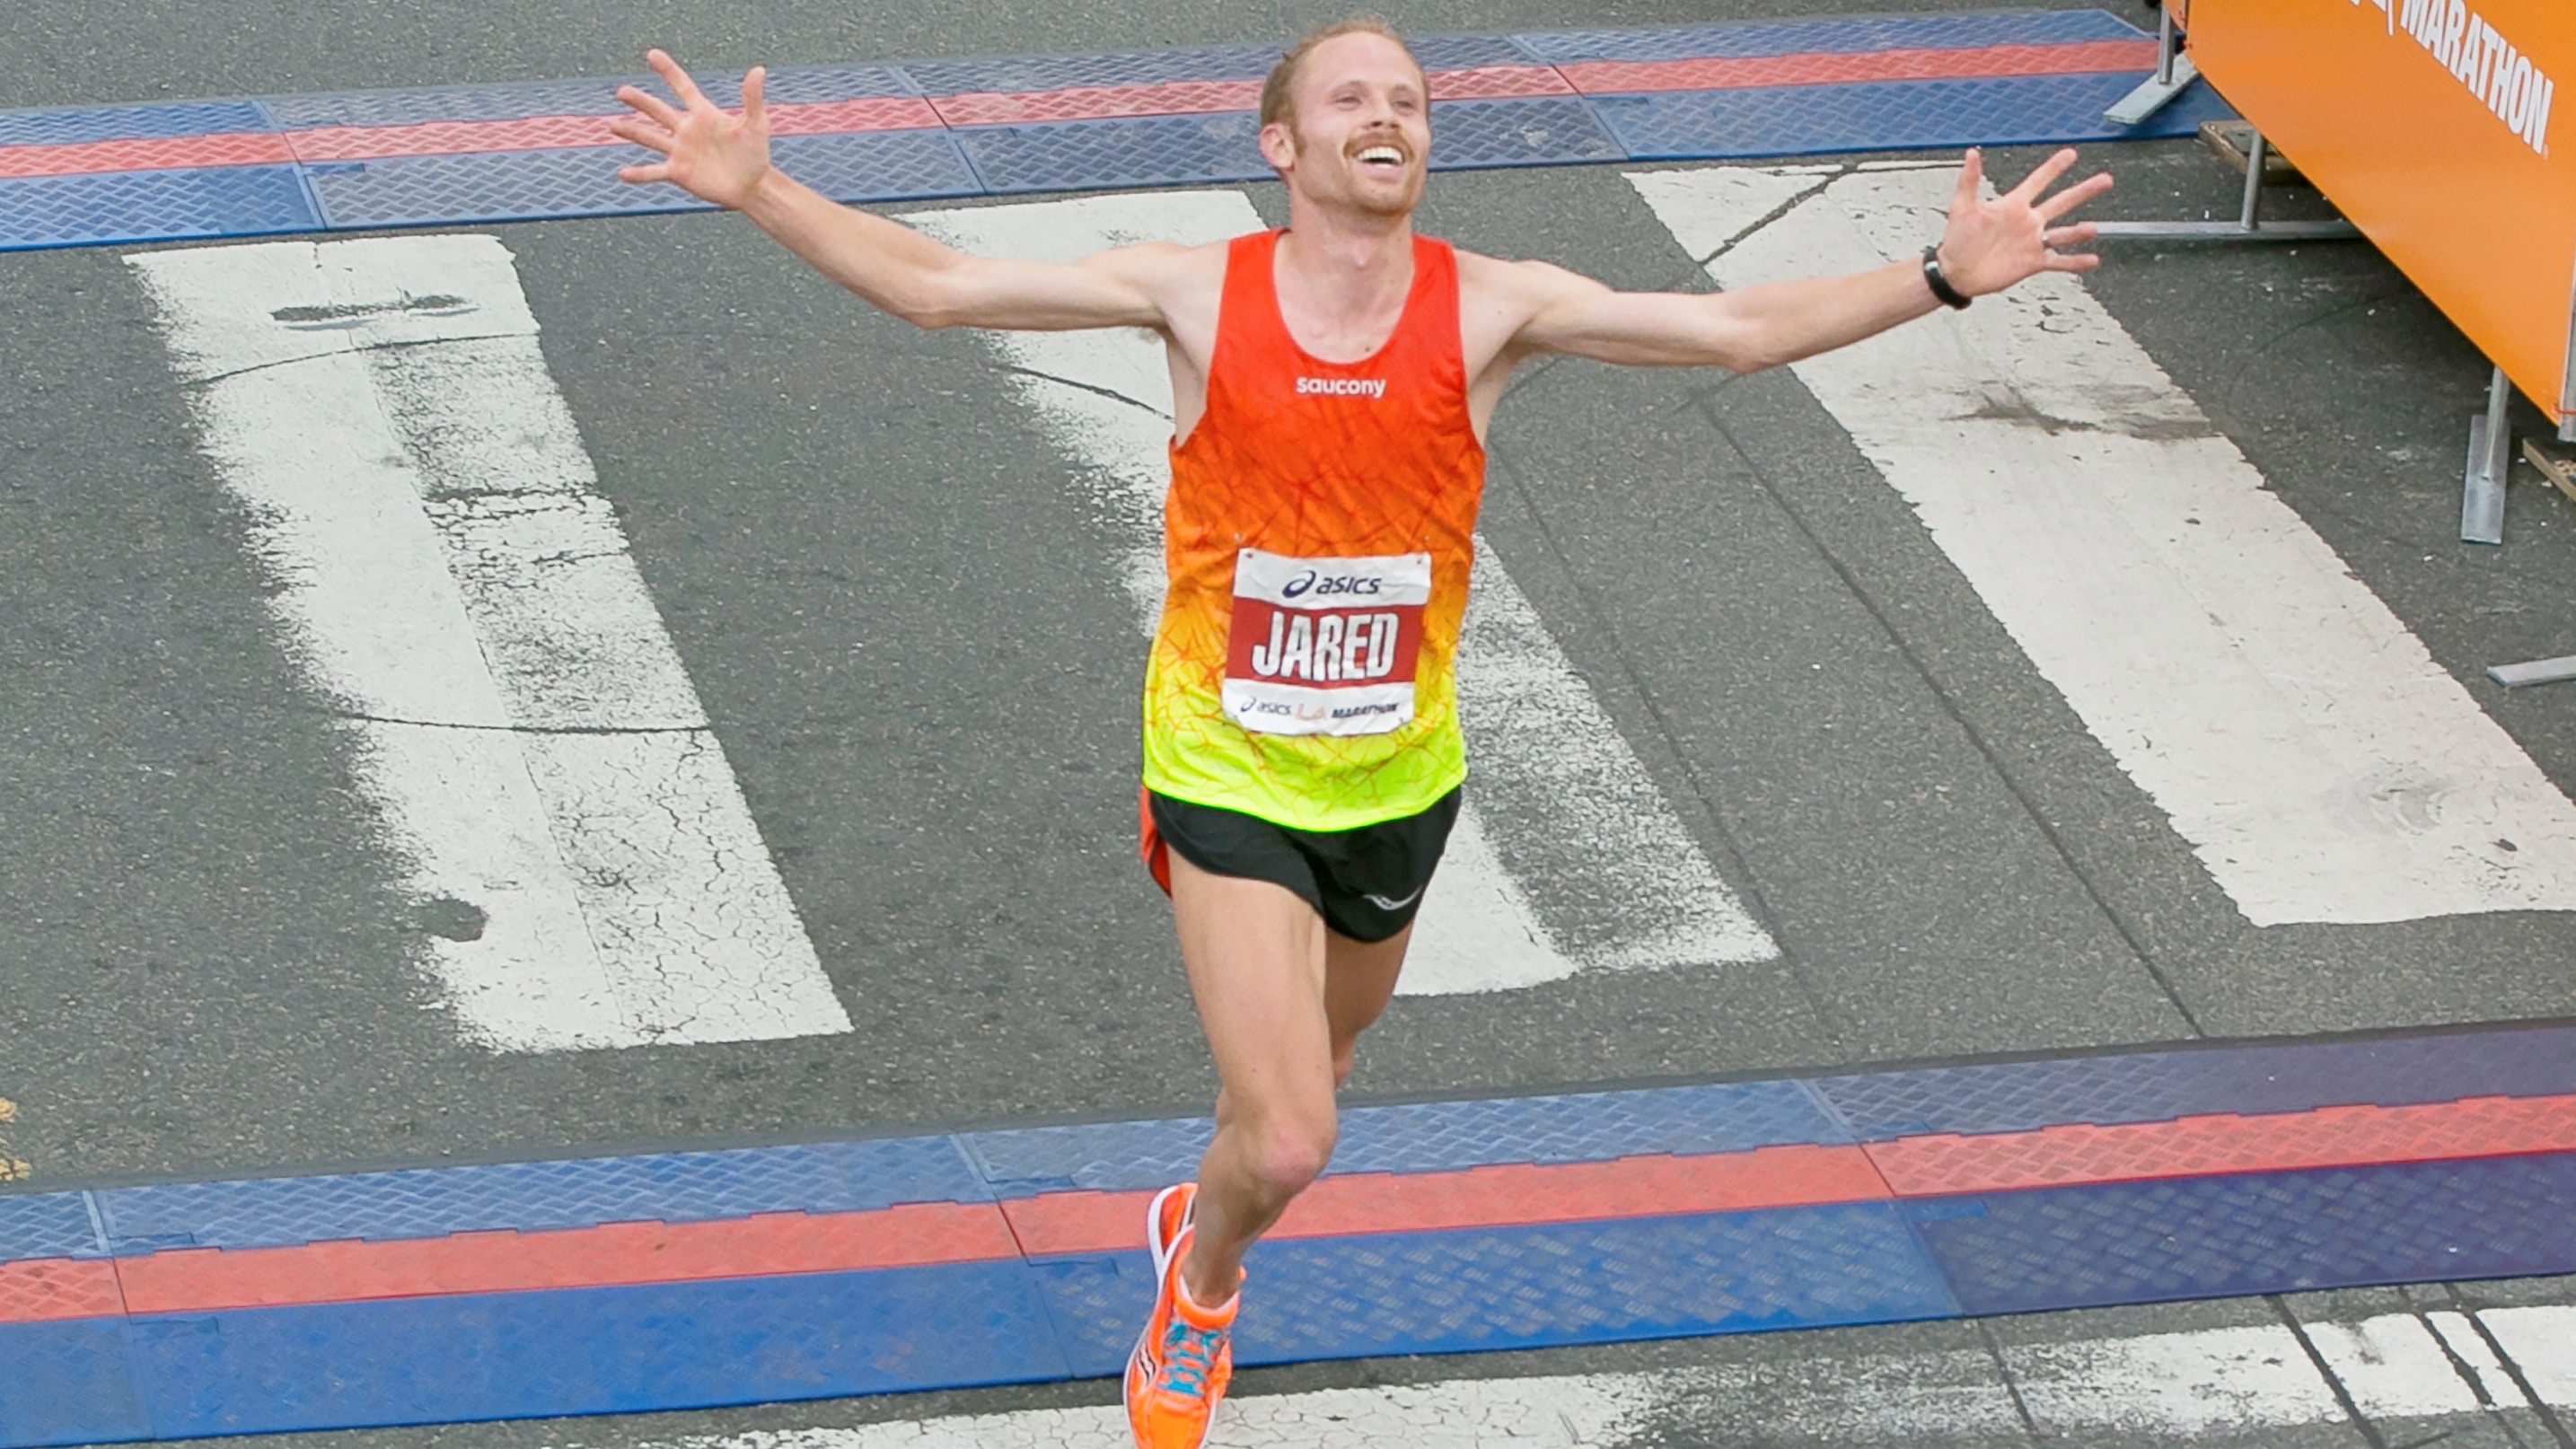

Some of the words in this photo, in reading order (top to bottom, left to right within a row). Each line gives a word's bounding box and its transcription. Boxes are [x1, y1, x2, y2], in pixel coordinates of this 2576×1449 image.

[1296, 377, 1387, 399] saucony
[1315, 576, 1382, 595] asics
[1252, 611, 1399, 681] JARED
